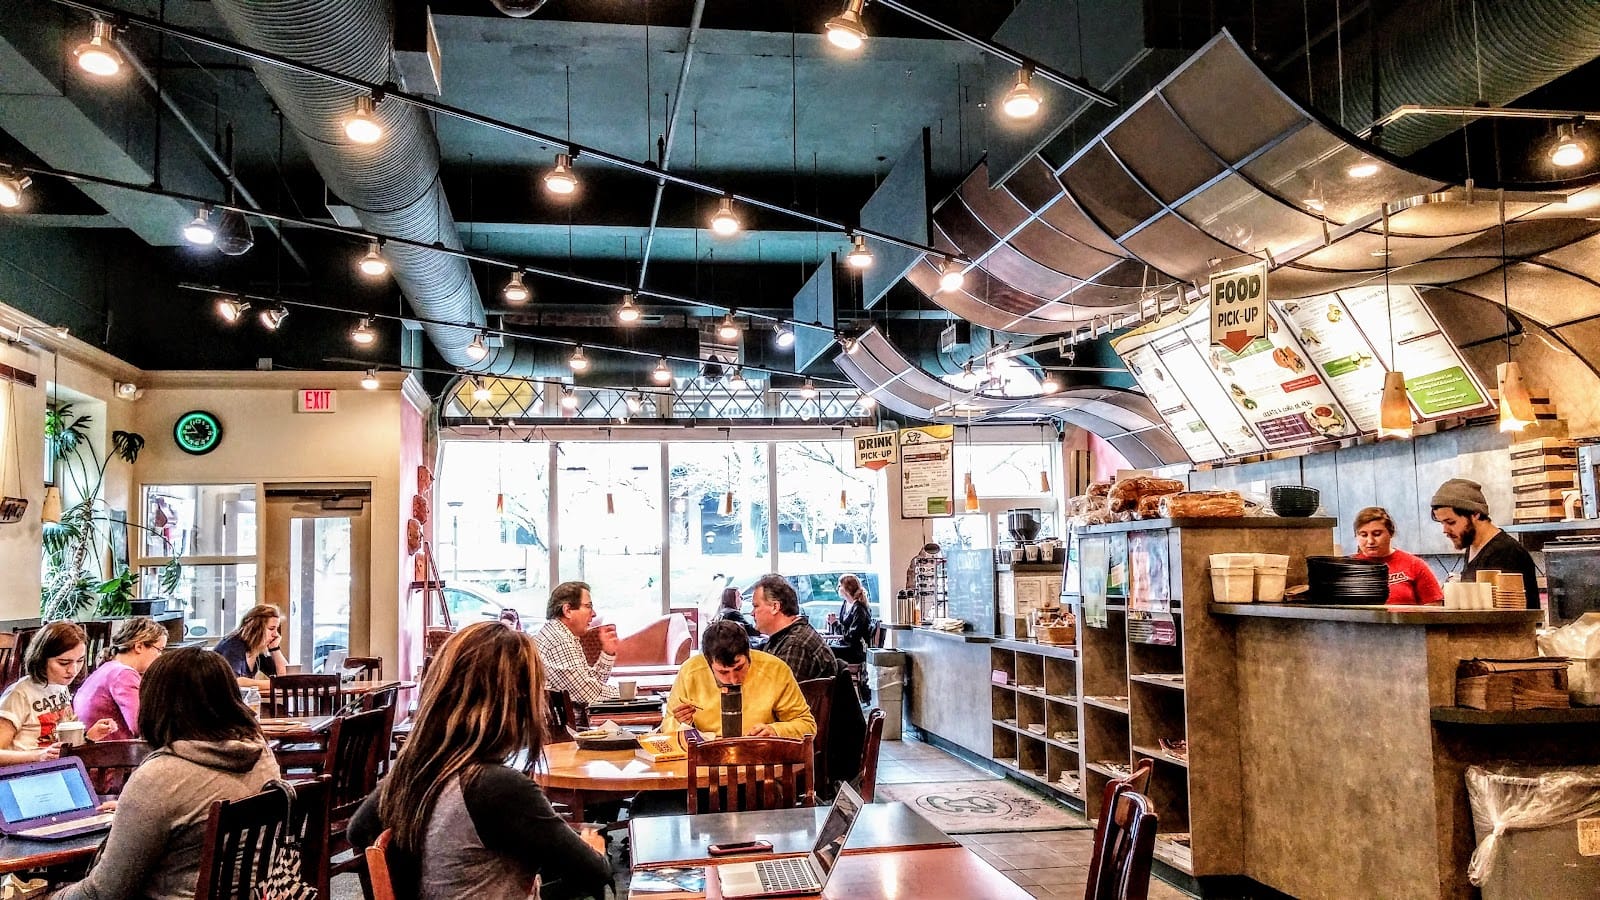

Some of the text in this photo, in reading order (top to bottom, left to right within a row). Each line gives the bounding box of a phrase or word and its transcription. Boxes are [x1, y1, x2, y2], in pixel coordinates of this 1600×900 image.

[1216, 274, 1261, 305] FOOD
[1218, 306, 1259, 328] PICK-UP
[305, 391, 331, 409] EXIT
[858, 436, 892, 450] DRINK
[861, 450, 892, 460] PICK-UP
[32, 694, 57, 712] CAT
